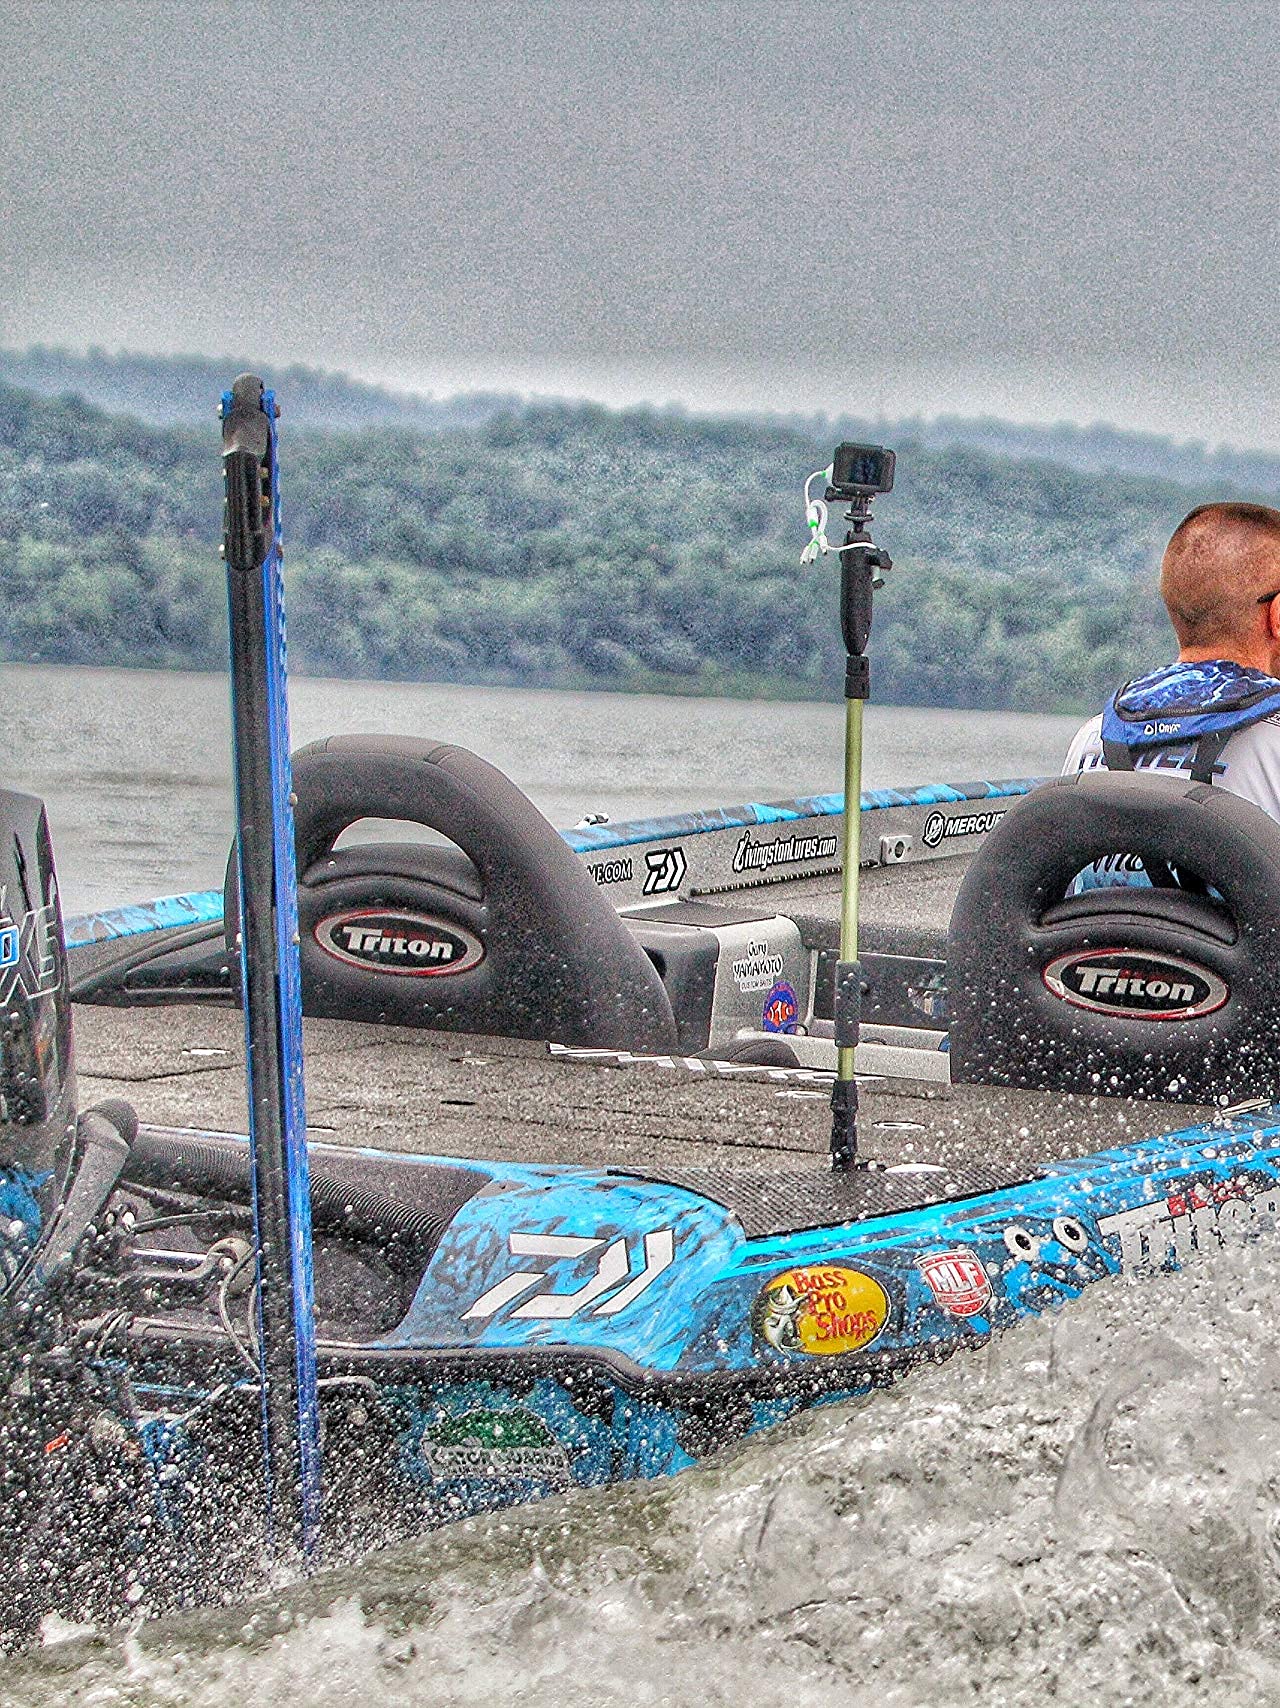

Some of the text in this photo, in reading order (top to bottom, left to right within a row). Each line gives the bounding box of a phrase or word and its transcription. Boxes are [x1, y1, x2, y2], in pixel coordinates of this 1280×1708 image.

[1158, 723, 1181, 734] Onyx
[342, 925, 455, 961] Triton
[1074, 965, 1196, 1002] Triton
[793, 1269, 849, 1294] Bass
[928, 1261, 980, 1292] MLF
[807, 1289, 847, 1315] Pro
[815, 1308, 879, 1342] Shops
